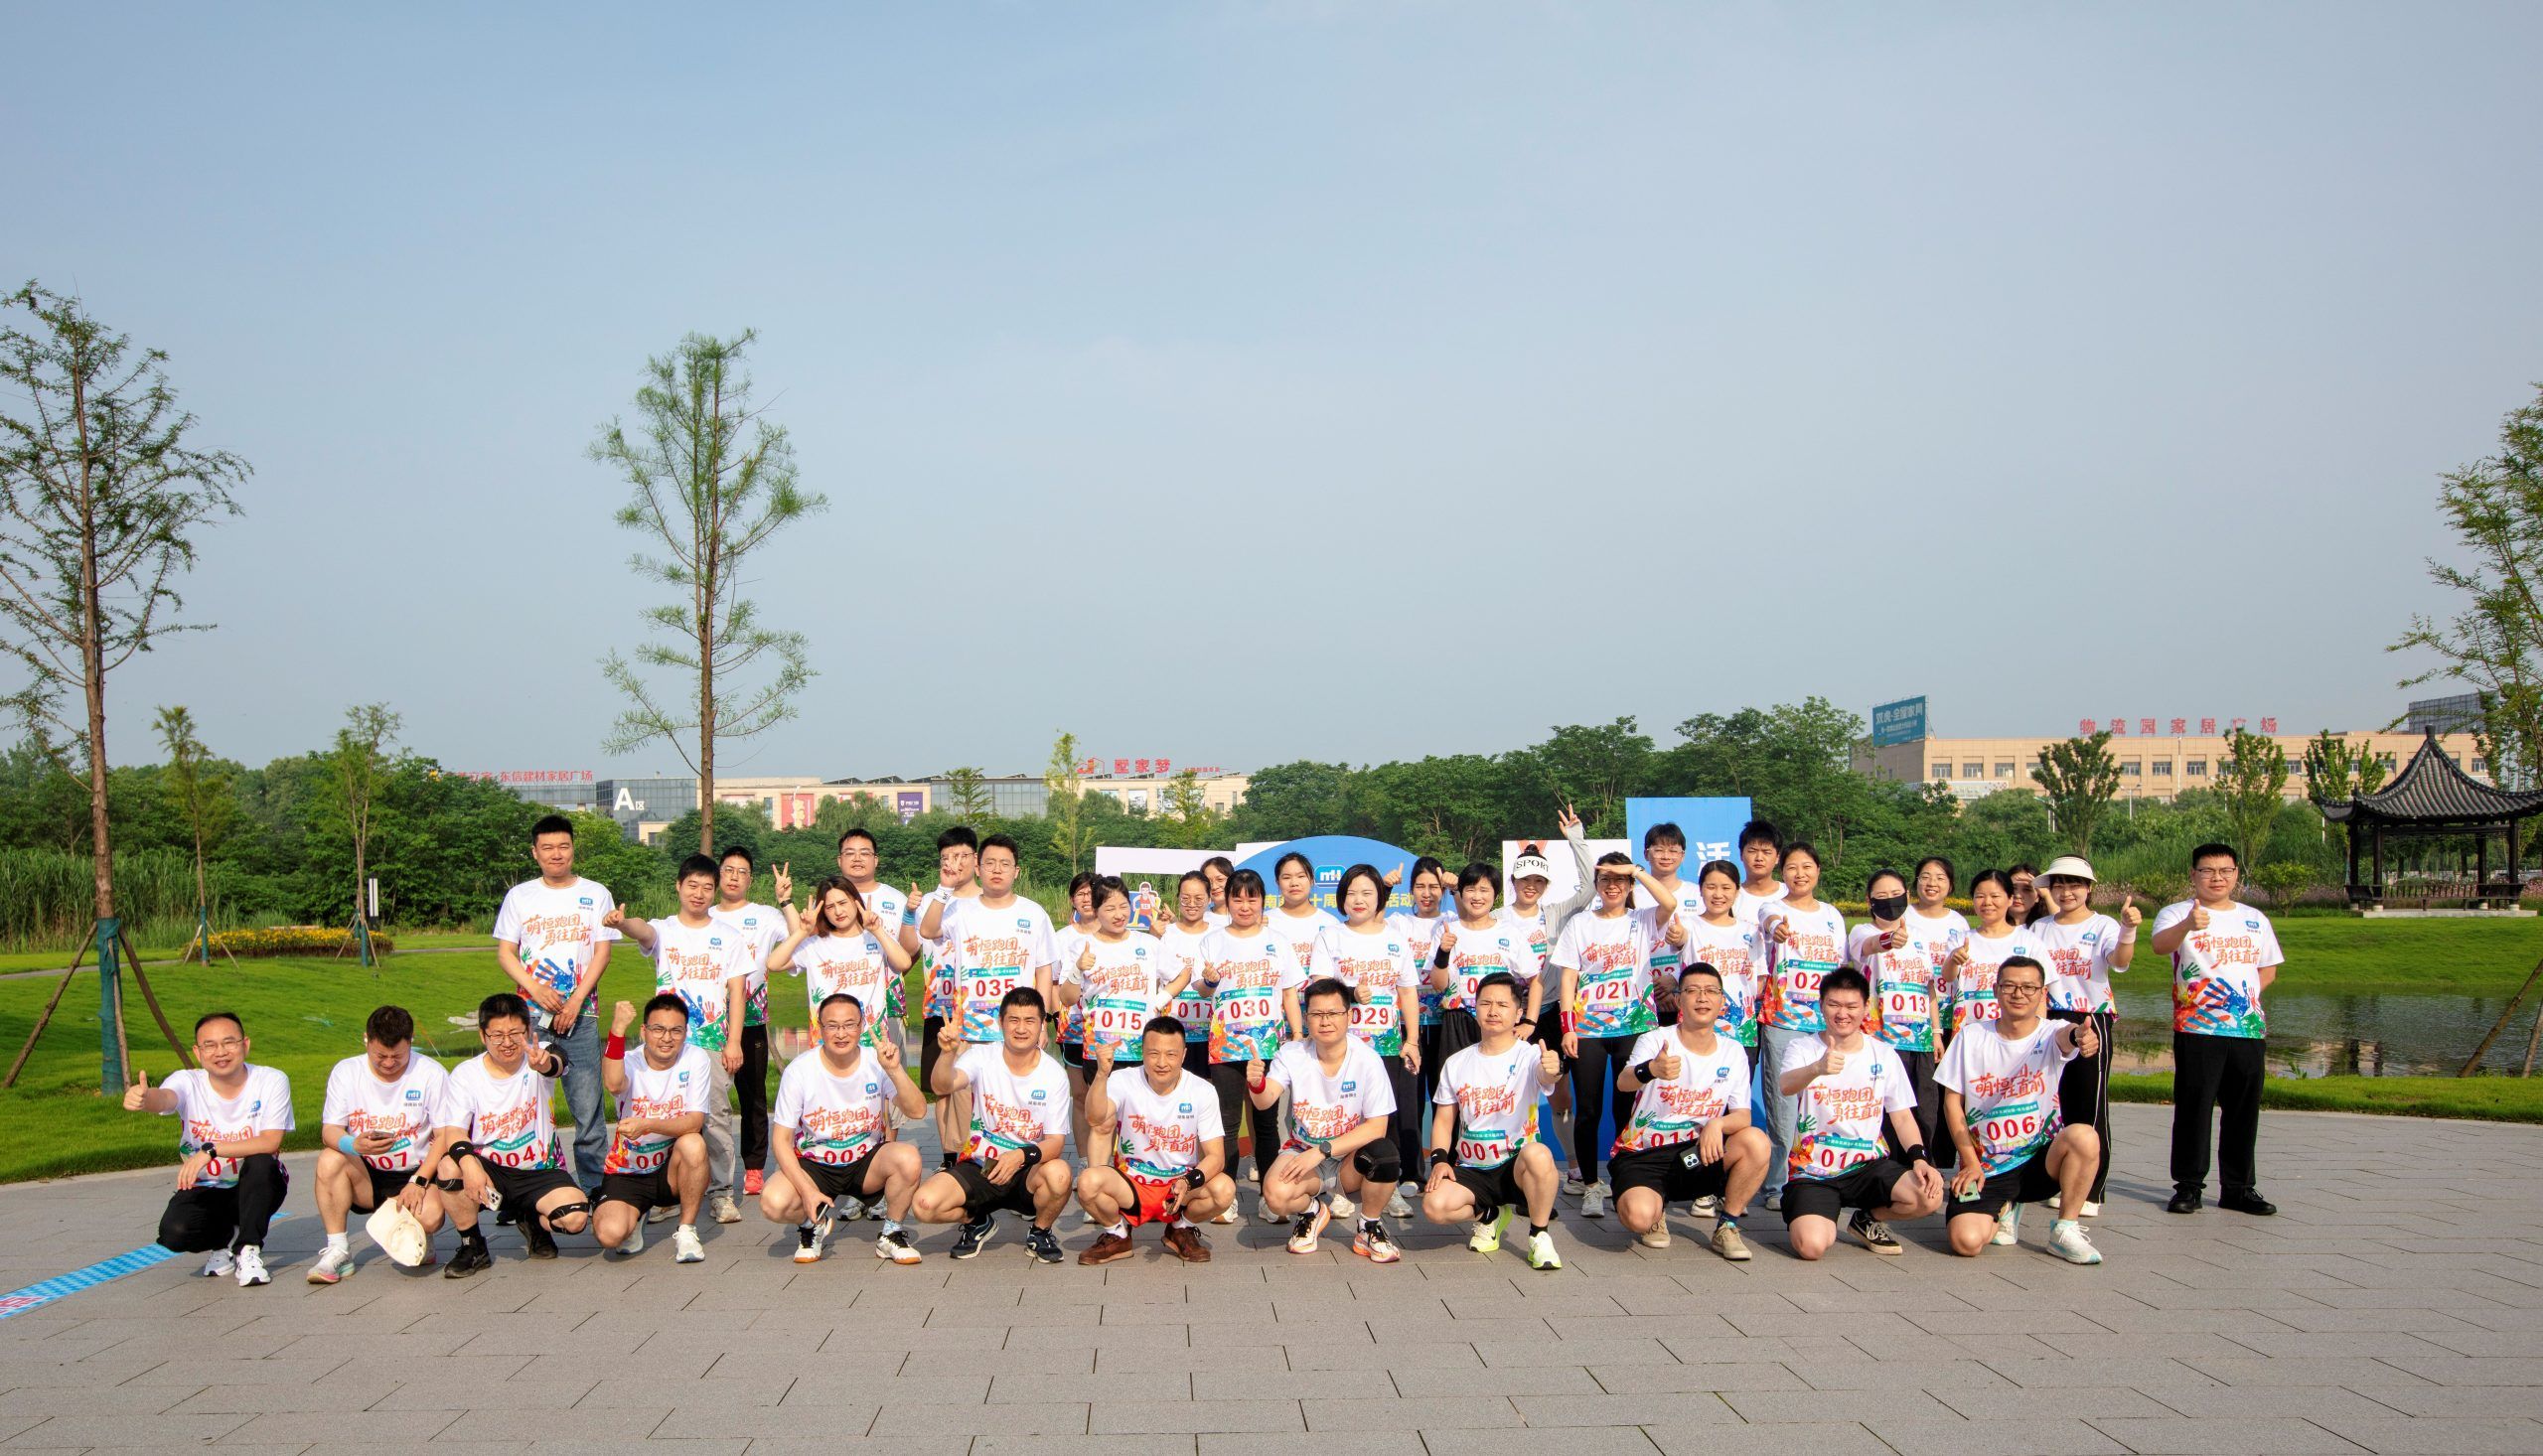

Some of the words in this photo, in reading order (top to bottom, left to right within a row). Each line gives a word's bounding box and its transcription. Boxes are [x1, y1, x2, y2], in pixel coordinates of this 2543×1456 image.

[2079, 717, 2279, 735] 物流园家居广场
[500, 770, 594, 783] 东信建材家居广场
[1516, 859, 1549, 872] SPORT
[1595, 980, 1629, 1000] 021
[1795, 972, 1822, 990] 02
[1178, 1002, 1212, 1018] 017
[1231, 998, 1270, 1019] 030
[1891, 993, 1926, 1013] 013
[1974, 1002, 2001, 1020] 03
[1102, 1011, 1141, 1030] 015
[1351, 1007, 1389, 1025] 029
[1987, 1115, 2035, 1141] 006
[489, 1145, 536, 1167] 004
[823, 1144, 867, 1164] 003
[1460, 1140, 1500, 1161] 001
[207, 1157, 239, 1177] 01
[636, 1151, 668, 1170] 00
